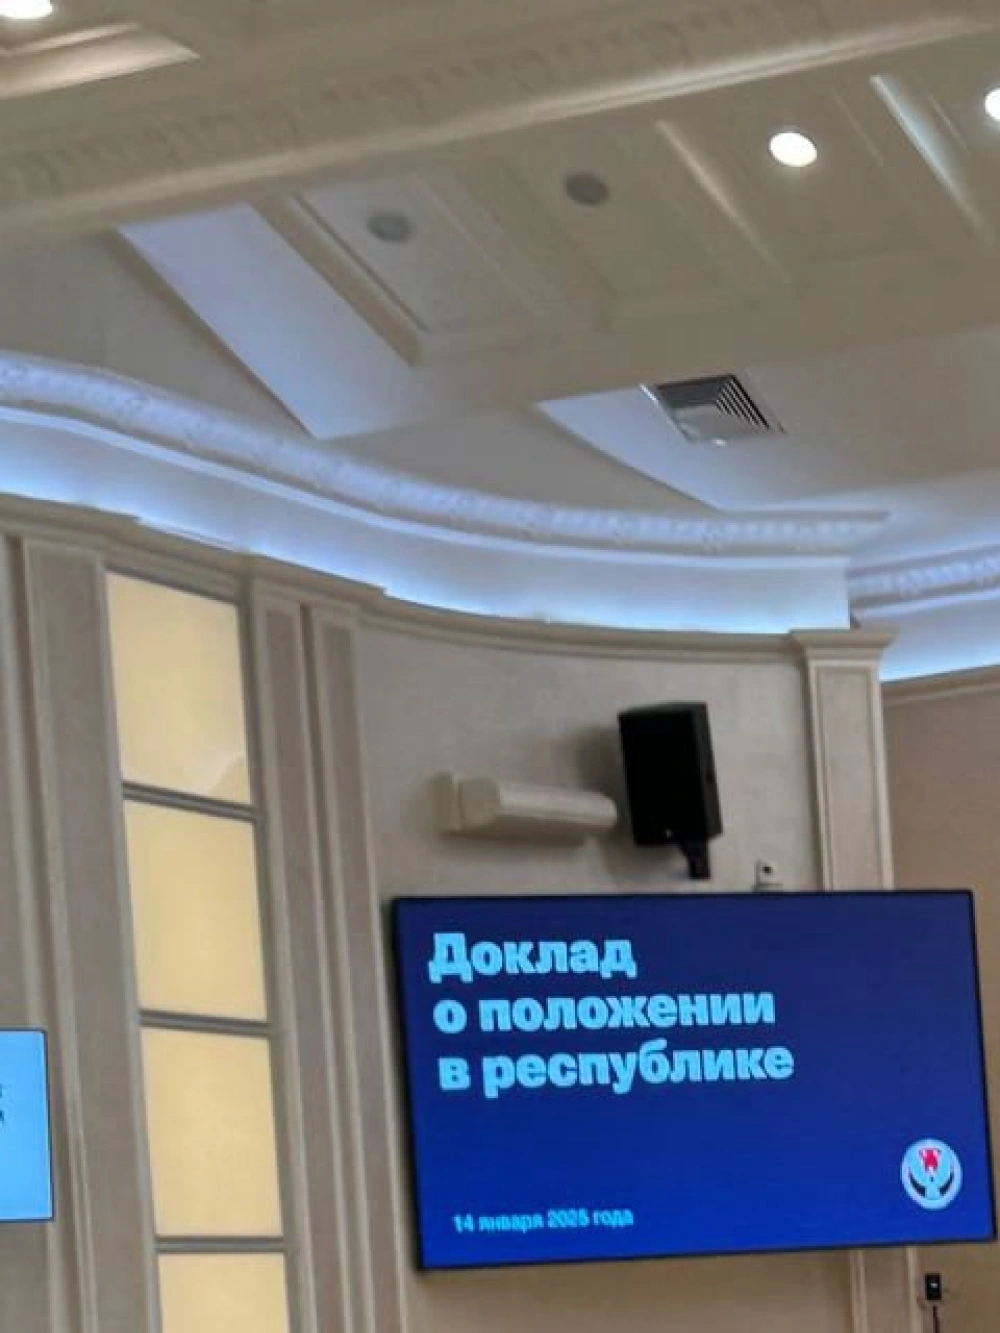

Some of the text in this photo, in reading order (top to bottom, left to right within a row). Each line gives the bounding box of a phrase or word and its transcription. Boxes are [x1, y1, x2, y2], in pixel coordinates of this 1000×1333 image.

[428, 932, 638, 984] Доклад
[432, 991, 776, 1034] о положении
[438, 1037, 795, 1099] в республике
[453, 1213, 474, 1233] 14
